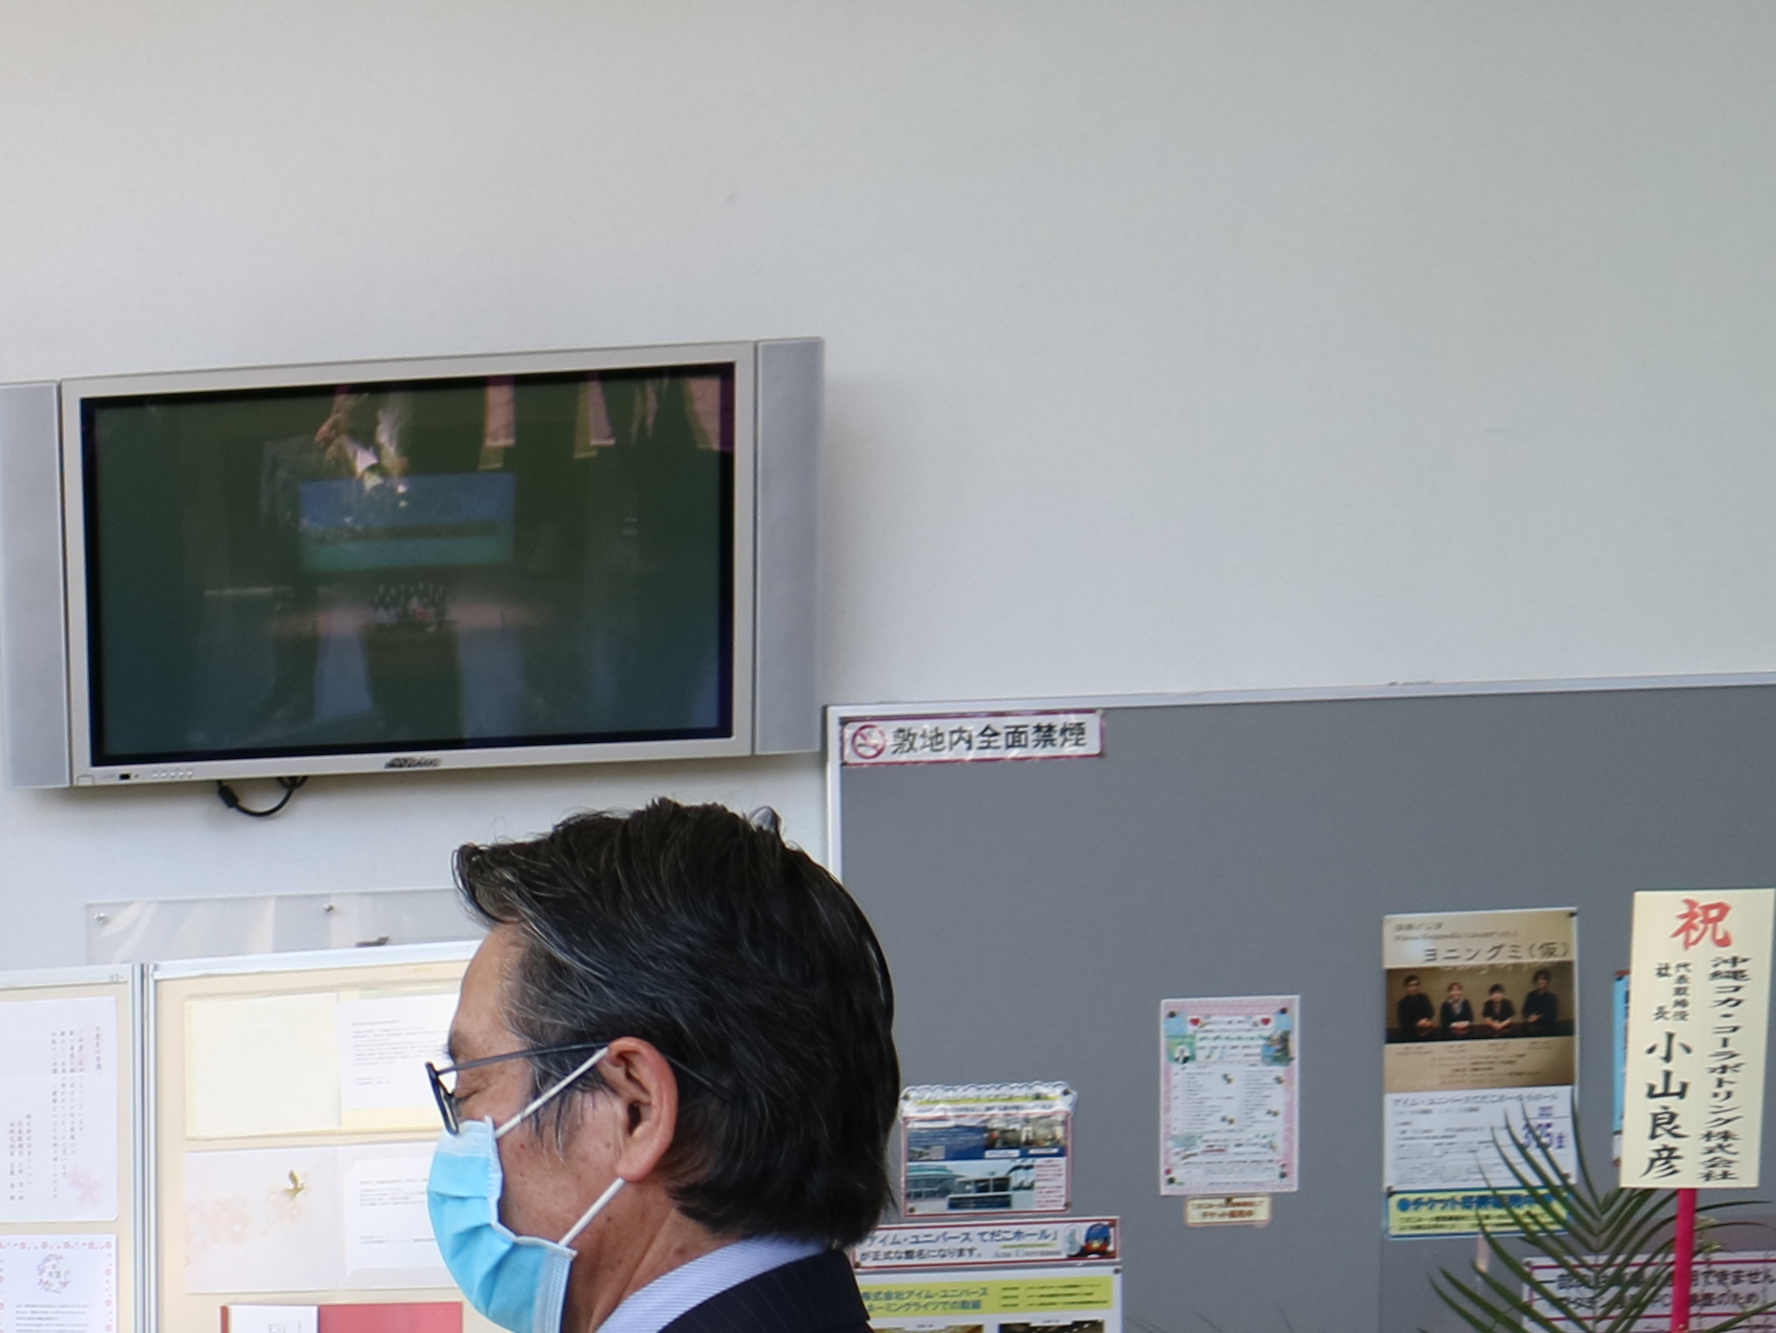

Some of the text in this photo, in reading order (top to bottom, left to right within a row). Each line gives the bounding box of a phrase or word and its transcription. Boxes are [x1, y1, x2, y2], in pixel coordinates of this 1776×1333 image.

[891, 721, 1087, 755] 敷地内全面禁煙
[1669, 898, 1732, 951] 祝
[1672, 961, 1692, 1022] 代表取締役
[1697, 955, 1752, 1182] 沖縄コカ・コーラボトリング株式会社
[1641, 1031, 1693, 1180] 小山良彦
